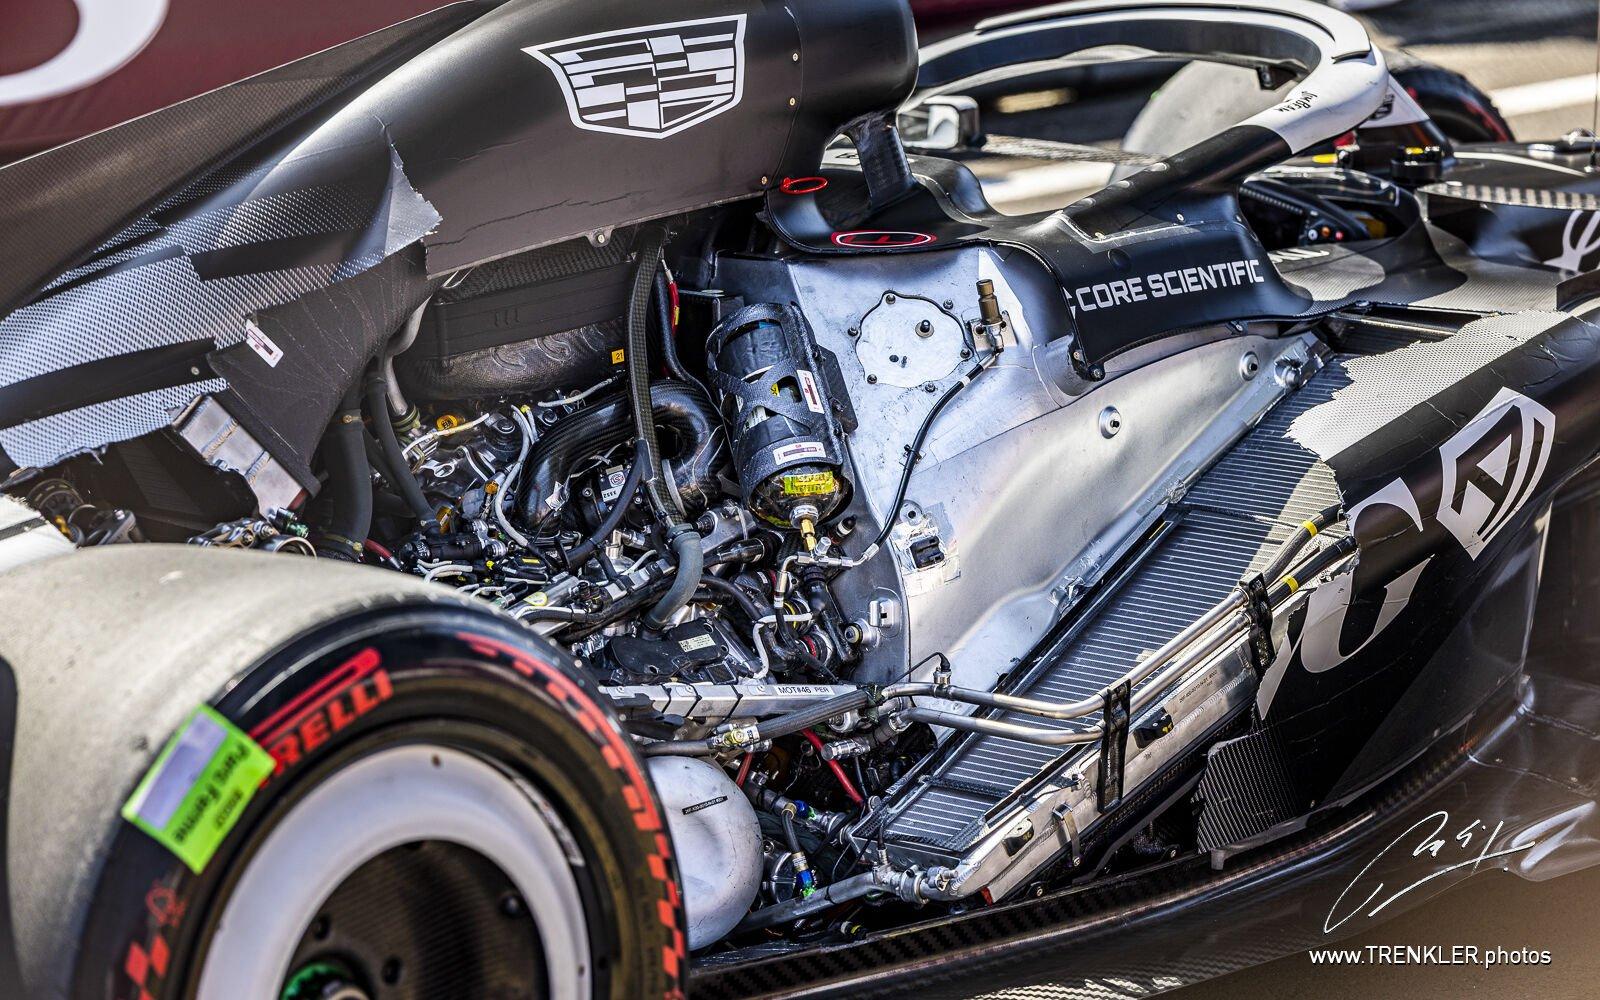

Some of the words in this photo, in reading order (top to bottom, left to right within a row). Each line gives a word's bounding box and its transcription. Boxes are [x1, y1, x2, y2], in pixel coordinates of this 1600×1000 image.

[1075, 277, 1148, 312] CORE
[1147, 259, 1265, 298] SCIENTIFIC
[248, 648, 394, 790] PRELLI
